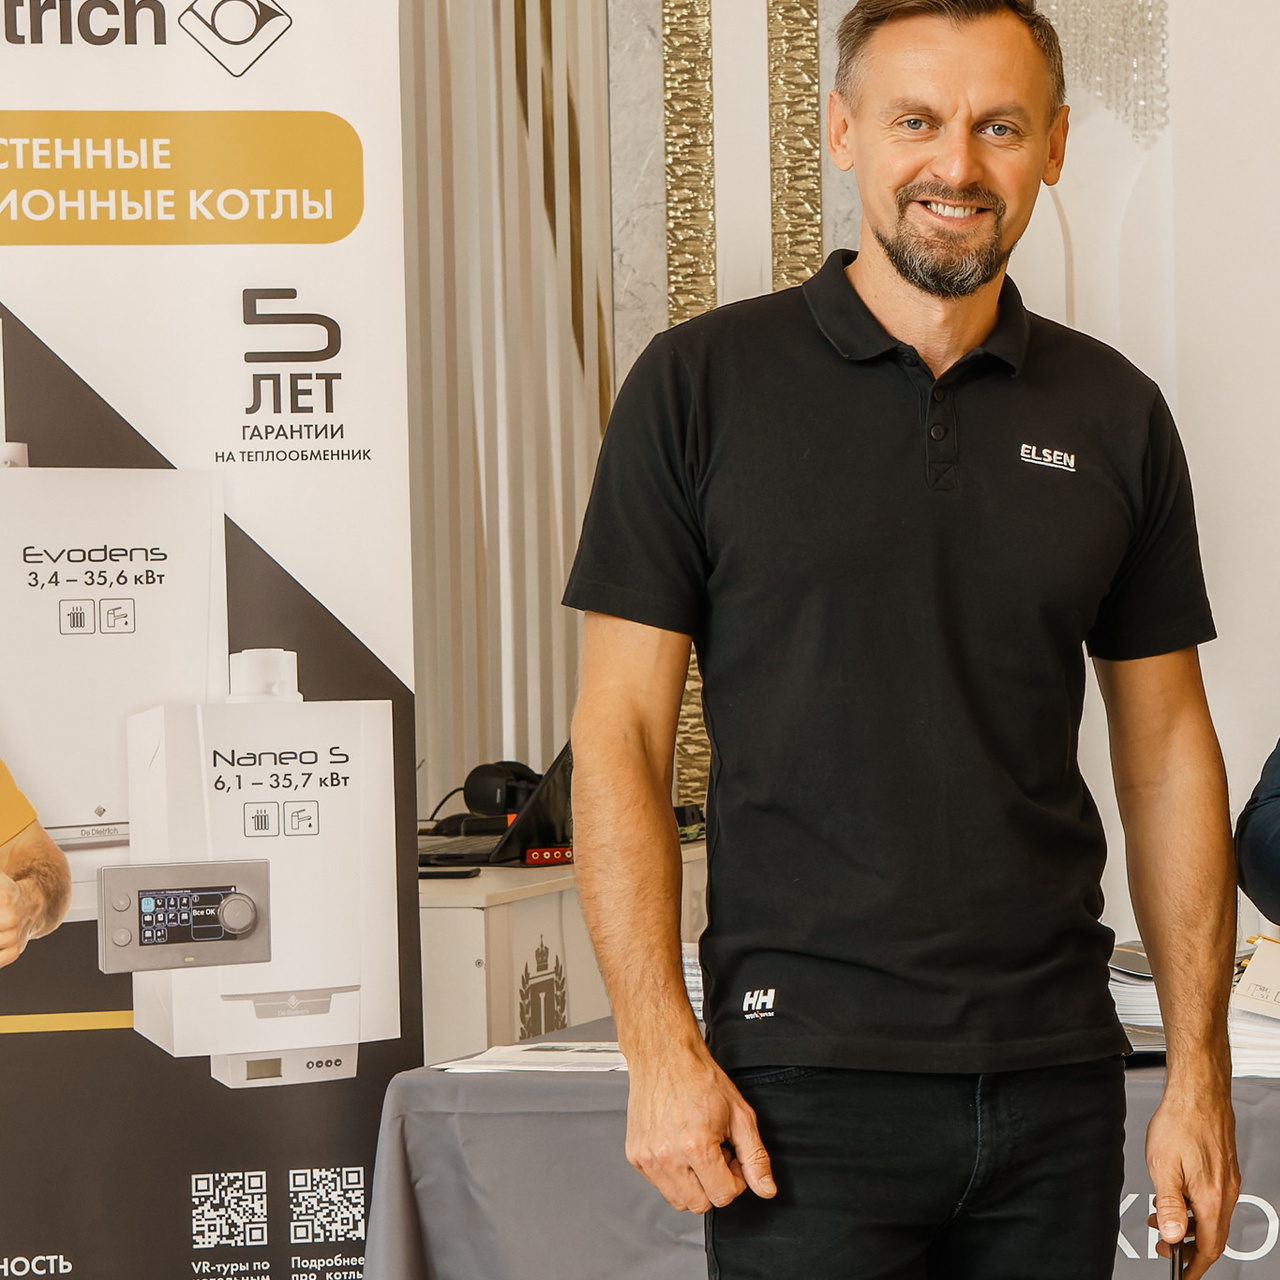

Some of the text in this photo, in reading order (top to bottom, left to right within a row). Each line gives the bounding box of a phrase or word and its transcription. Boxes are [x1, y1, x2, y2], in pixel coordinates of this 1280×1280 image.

[189, 189, 333, 221] КОТЛЫ
[242, 287, 342, 364] 5
[245, 372, 342, 415] ЛЕТ
[242, 423, 344, 441] ГАРАНТИИ
[215, 448, 372, 464] НА ТЕПЛООБМЕННИК
[1020, 443, 1075, 468] ELSEN
[22, 545, 168, 564] Evodens
[27, 571, 60, 590] 3,4
[84, 569, 128, 588] 35,6
[134, 570, 166, 586] кВт
[212, 746, 350, 768] Naneo S
[213, 774, 242, 793] 6,1
[269, 772, 313, 791] 35,7
[318, 772, 350, 788] кВт
[742, 988, 776, 1011] HH
[191, 1260, 271, 1276] VR-туры по
[291, 1253, 366, 1271] Подробнее
